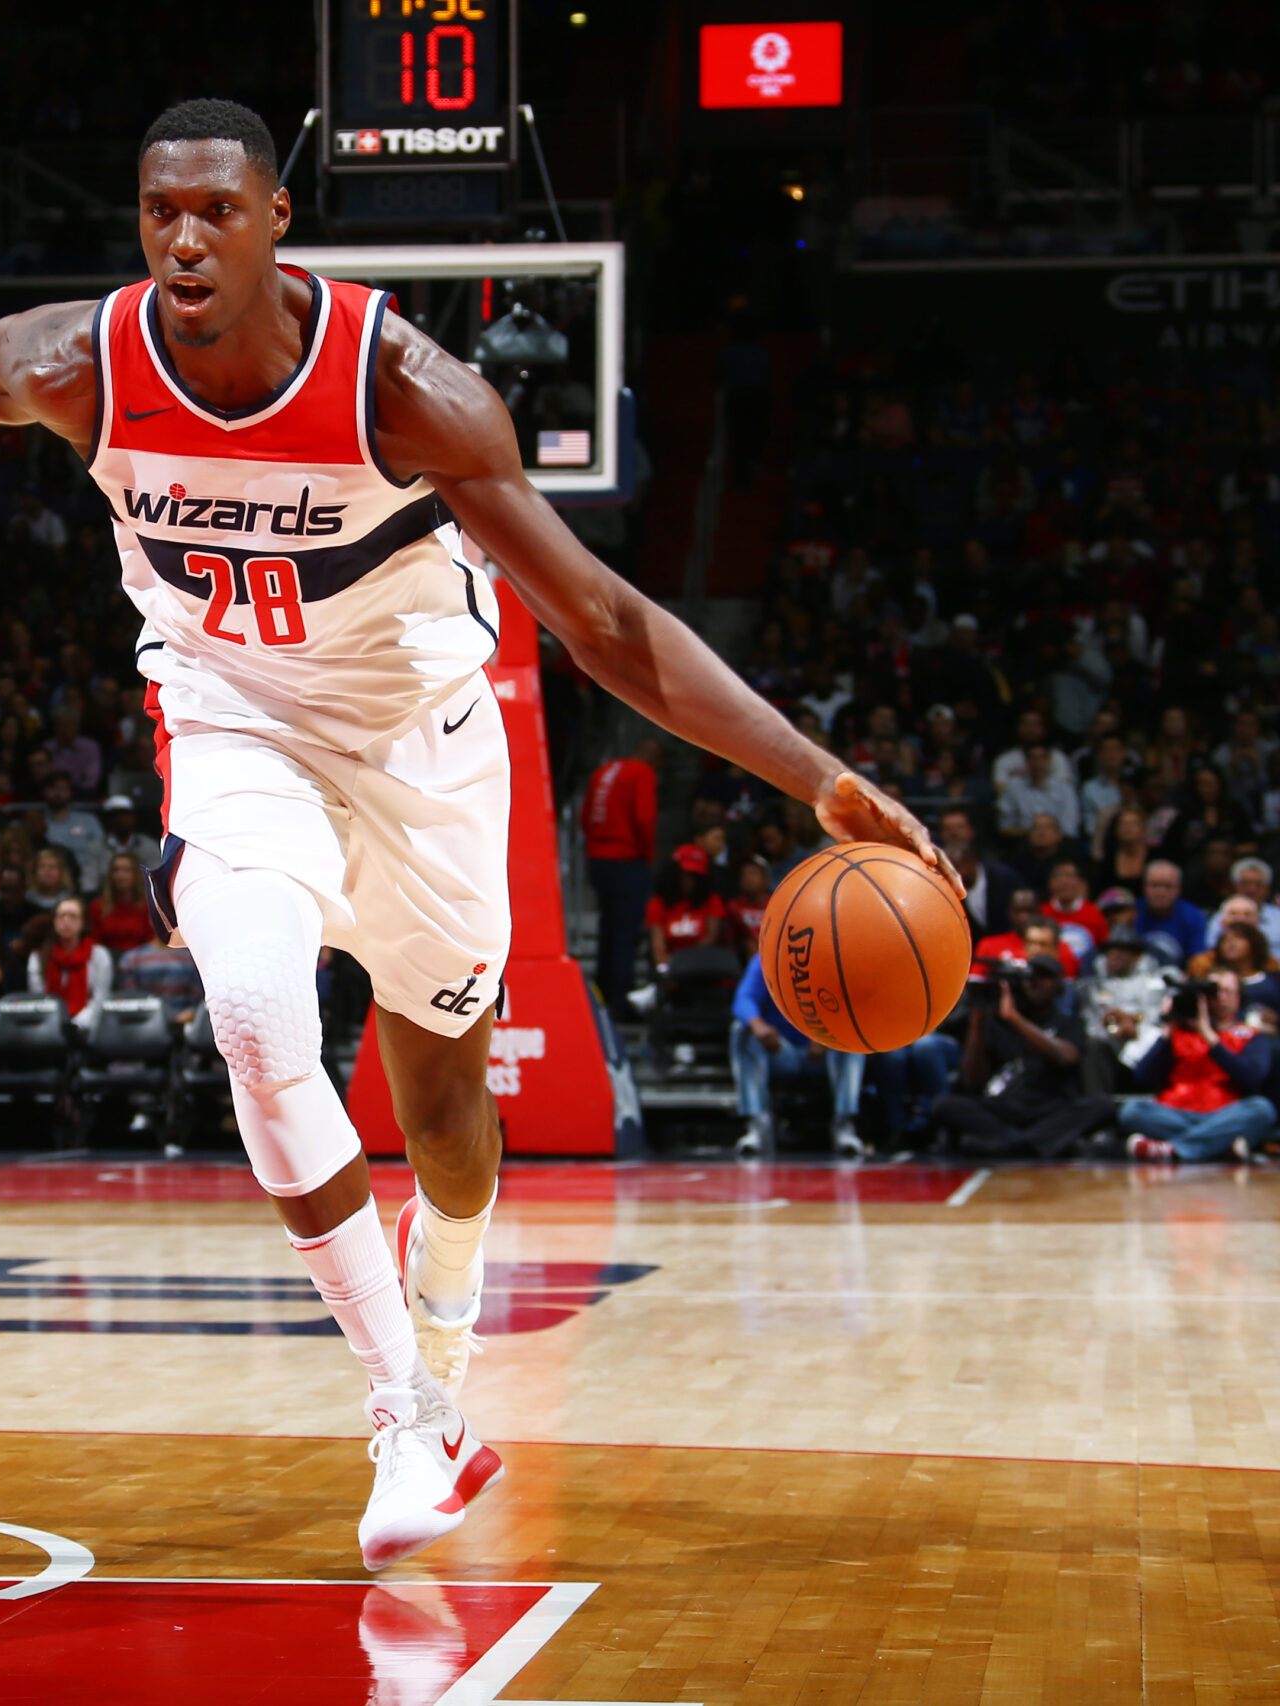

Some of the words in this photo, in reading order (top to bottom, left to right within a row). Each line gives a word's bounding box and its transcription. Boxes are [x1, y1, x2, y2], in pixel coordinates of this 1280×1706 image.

[401, 25, 475, 110] 10
[380, 126, 504, 153] TISSOT
[1105, 269, 1280, 312] ETIH
[123, 482, 348, 536] wizards
[183, 550, 308, 647] 28
[430, 973, 480, 1016] dc
